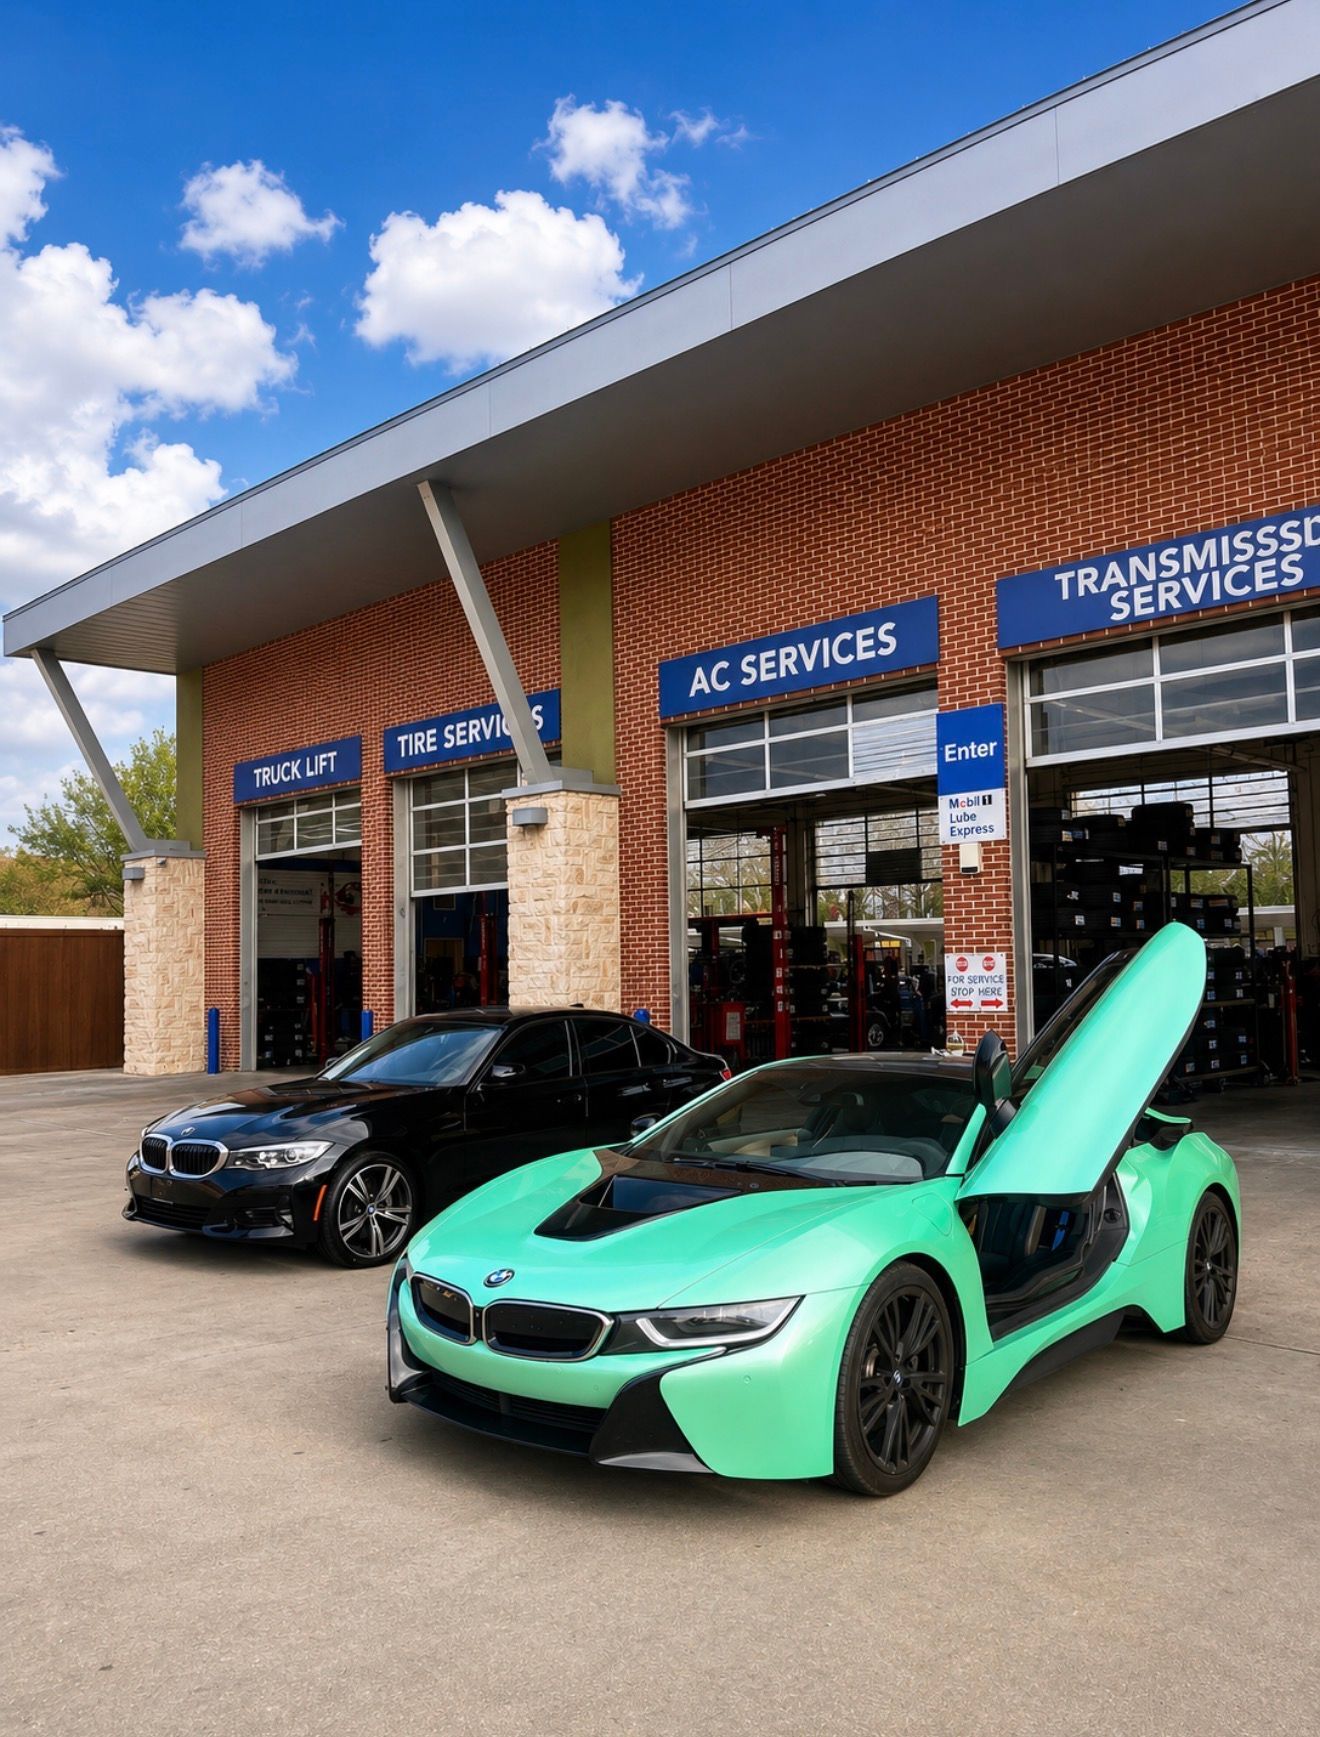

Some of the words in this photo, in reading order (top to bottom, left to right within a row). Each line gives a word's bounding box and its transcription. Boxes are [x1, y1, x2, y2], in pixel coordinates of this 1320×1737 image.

[1110, 553, 1304, 621] SERVICES
[689, 661, 731, 698] AC
[740, 622, 897, 686] SERVICES
[397, 728, 438, 758] TIRE
[944, 741, 998, 762] Enter
[253, 759, 302, 788] TRUCK
[306, 751, 337, 777] LIFT
[950, 812, 977, 824] Lube
[950, 825, 995, 838] Express
